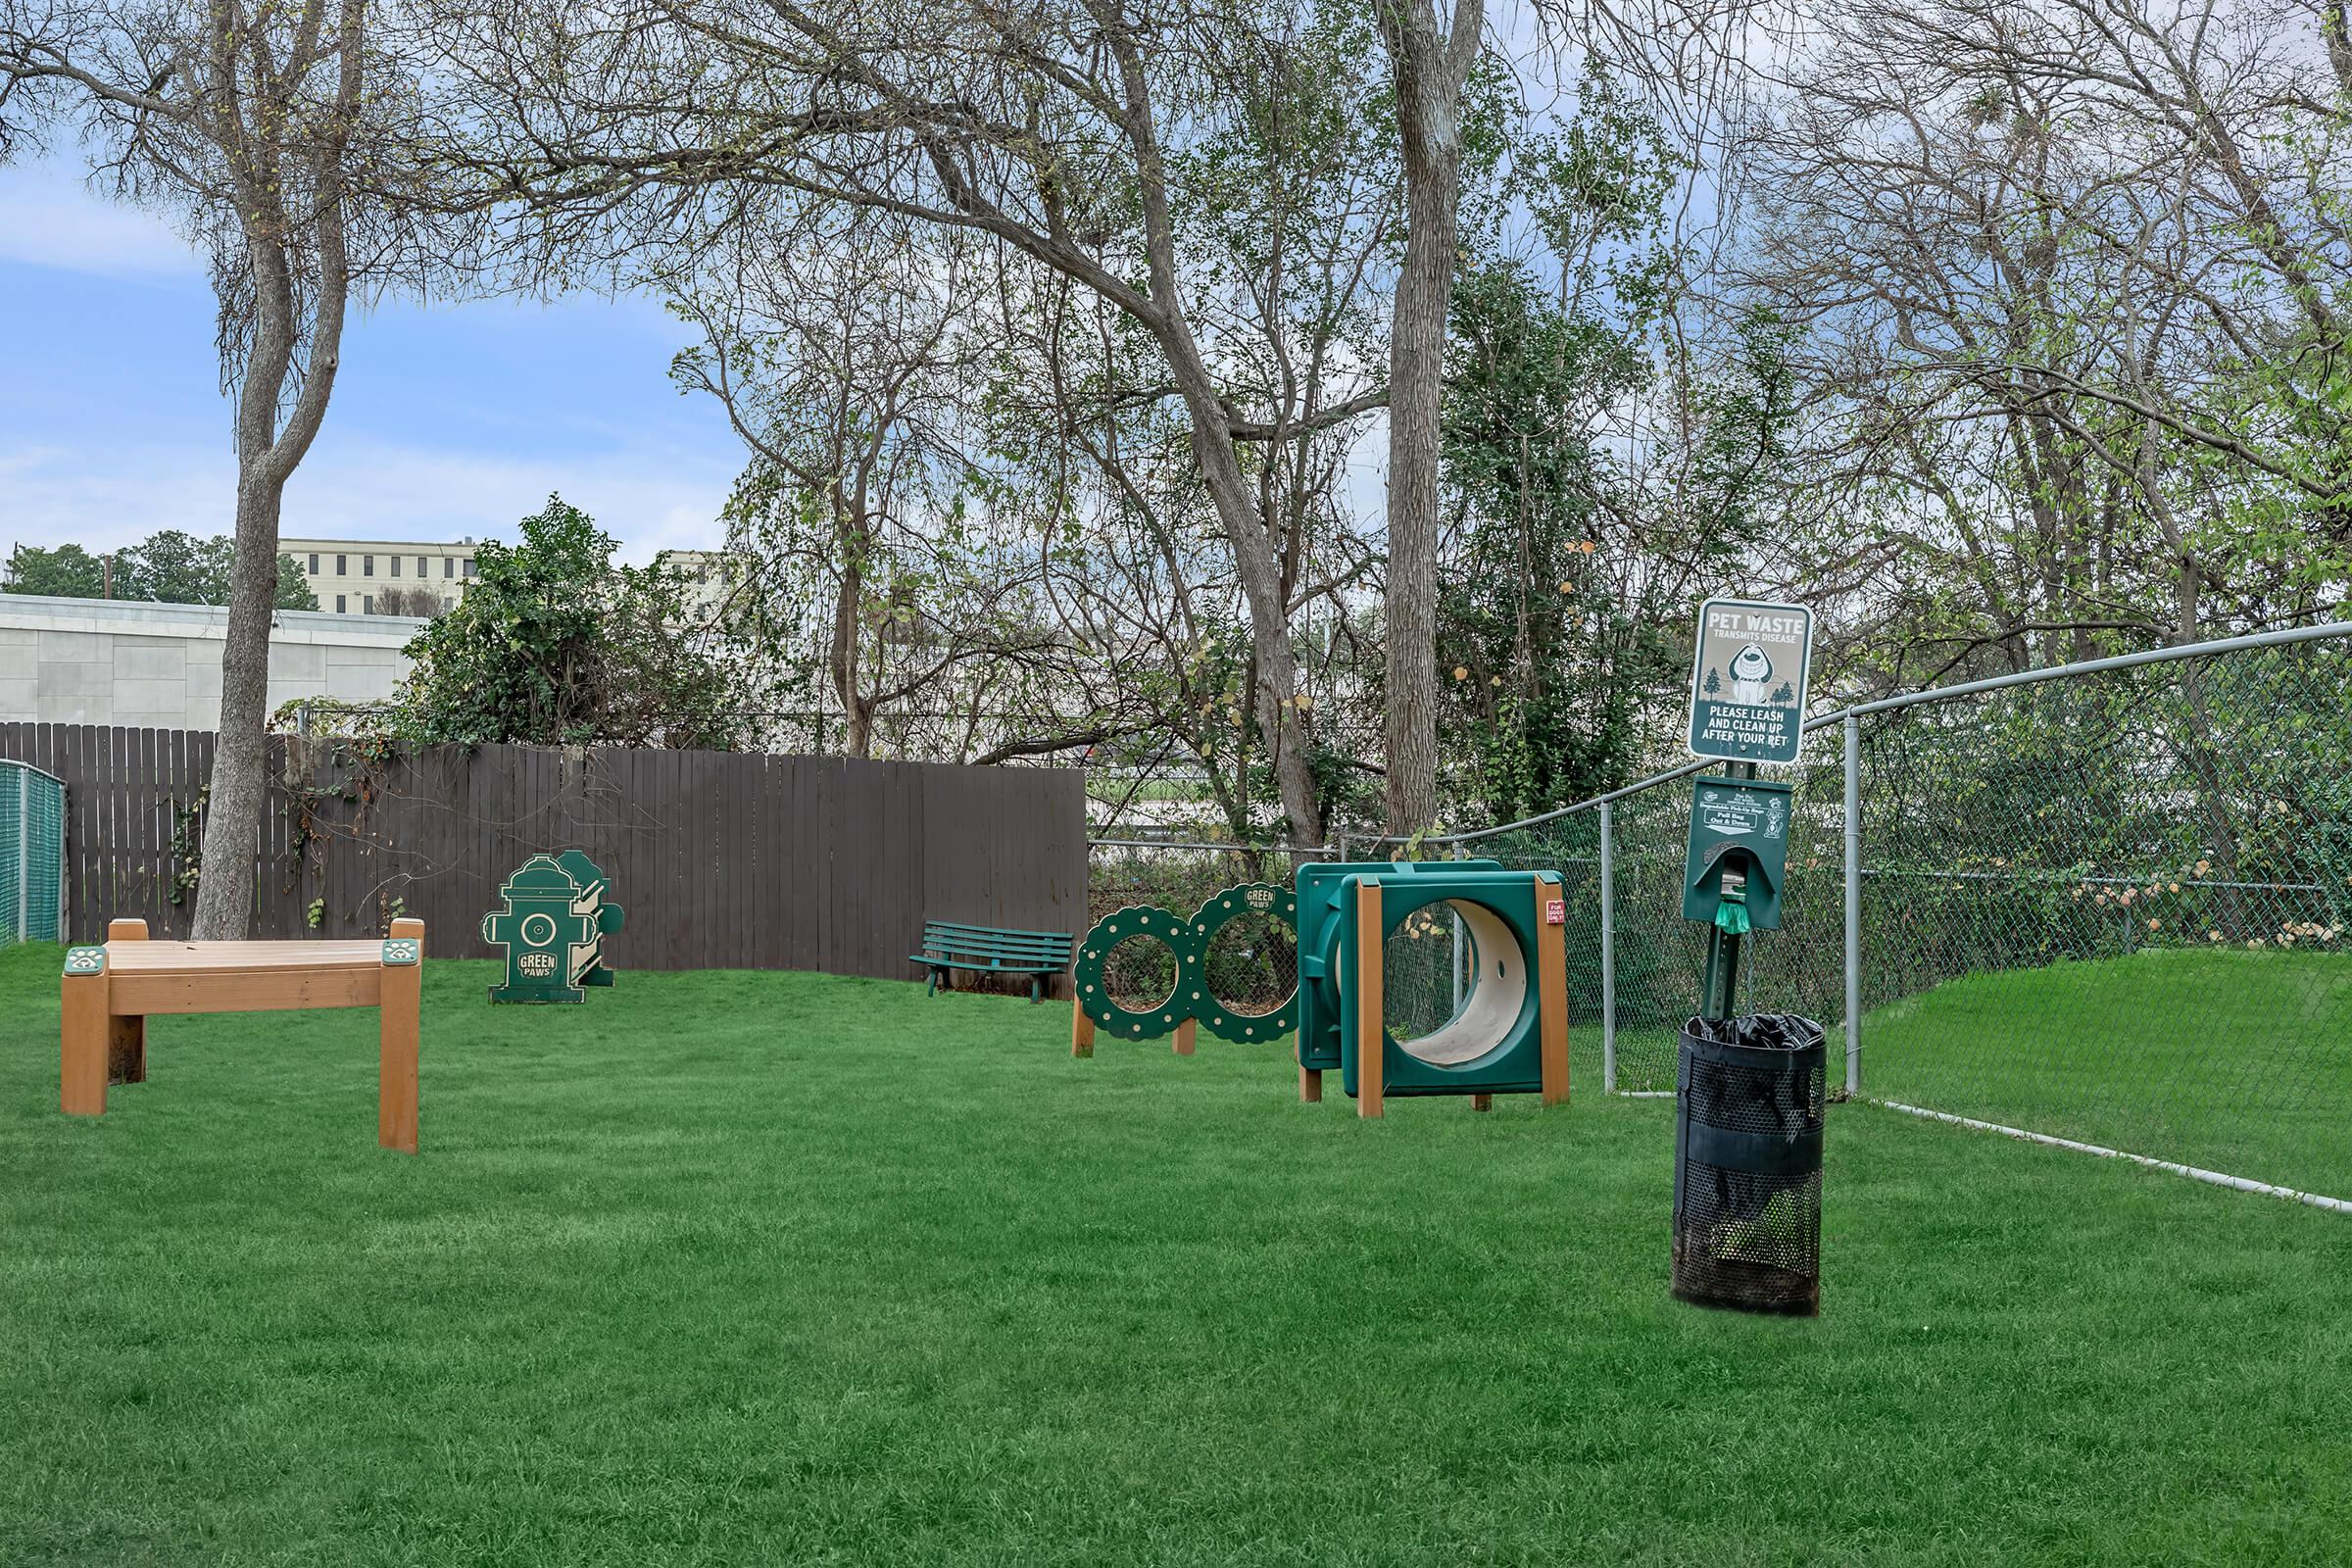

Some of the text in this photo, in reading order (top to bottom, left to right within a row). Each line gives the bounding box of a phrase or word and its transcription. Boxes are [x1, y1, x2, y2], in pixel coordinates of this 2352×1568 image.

[1708, 612, 1804, 634] PET WASTE
[1713, 629, 1796, 644] TRANSMITS DISEASE
[1709, 706, 1785, 722] PLEASE LEASH
[1708, 717, 1784, 734] AND CLEAN UP
[1701, 728, 1735, 742] AFTER
[1738, 732, 1766, 744] YOUR
[1247, 890, 1273, 902] GREEN
[520, 955, 555, 968] GREEN
[524, 967, 550, 976] PAWS
